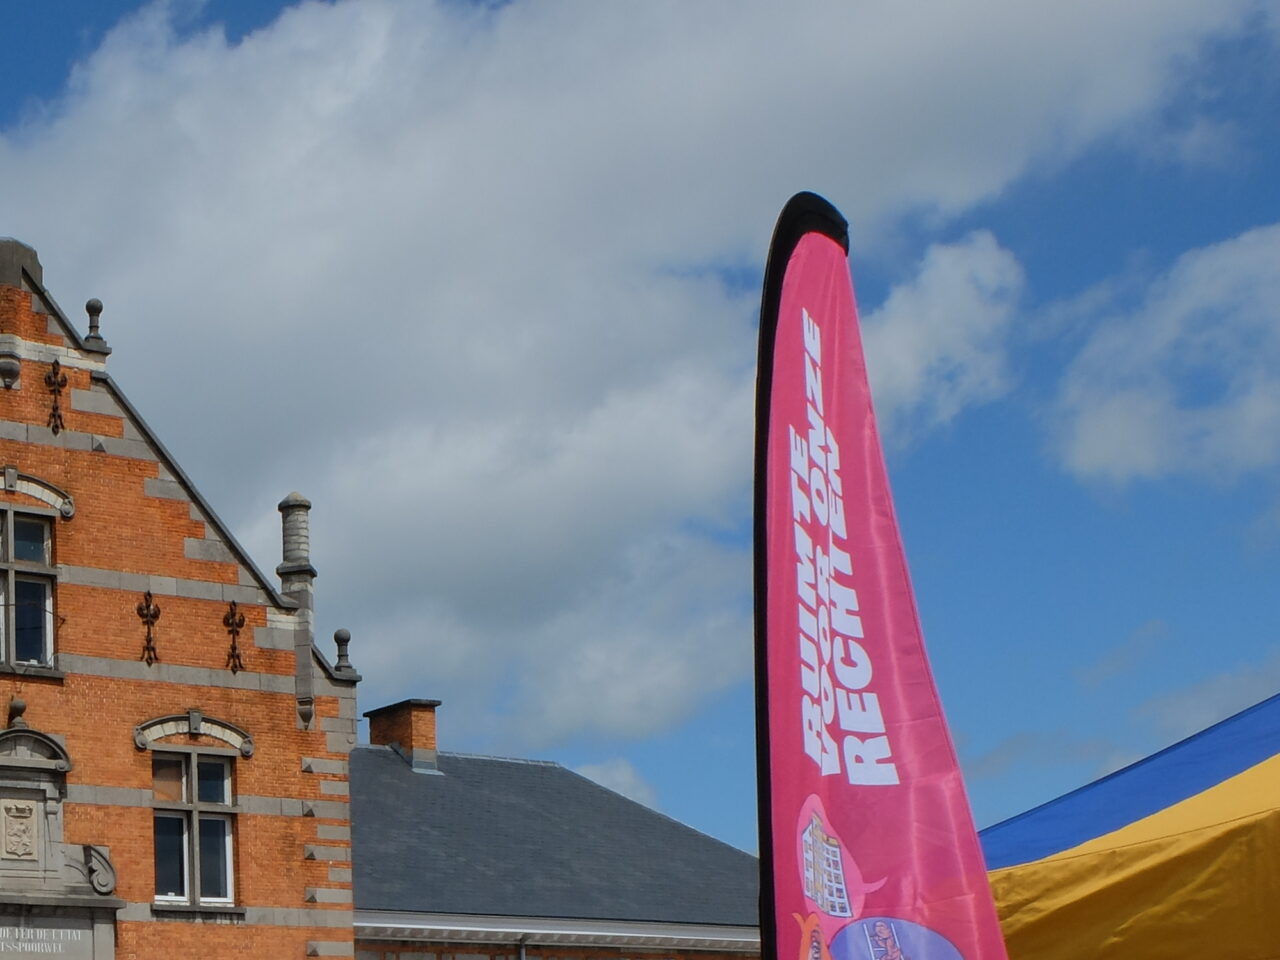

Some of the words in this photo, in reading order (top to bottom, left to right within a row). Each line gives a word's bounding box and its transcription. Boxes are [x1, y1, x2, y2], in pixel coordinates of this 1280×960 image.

[802, 307, 829, 526] ONZE
[789, 424, 821, 767] RUIMTE
[816, 545, 841, 776] VOOR
[826, 426, 900, 785] RECHTEN
[0, 927, 12, 938] DE
[15, 927, 34, 939] FER
[36, 929, 49, 940] DE
